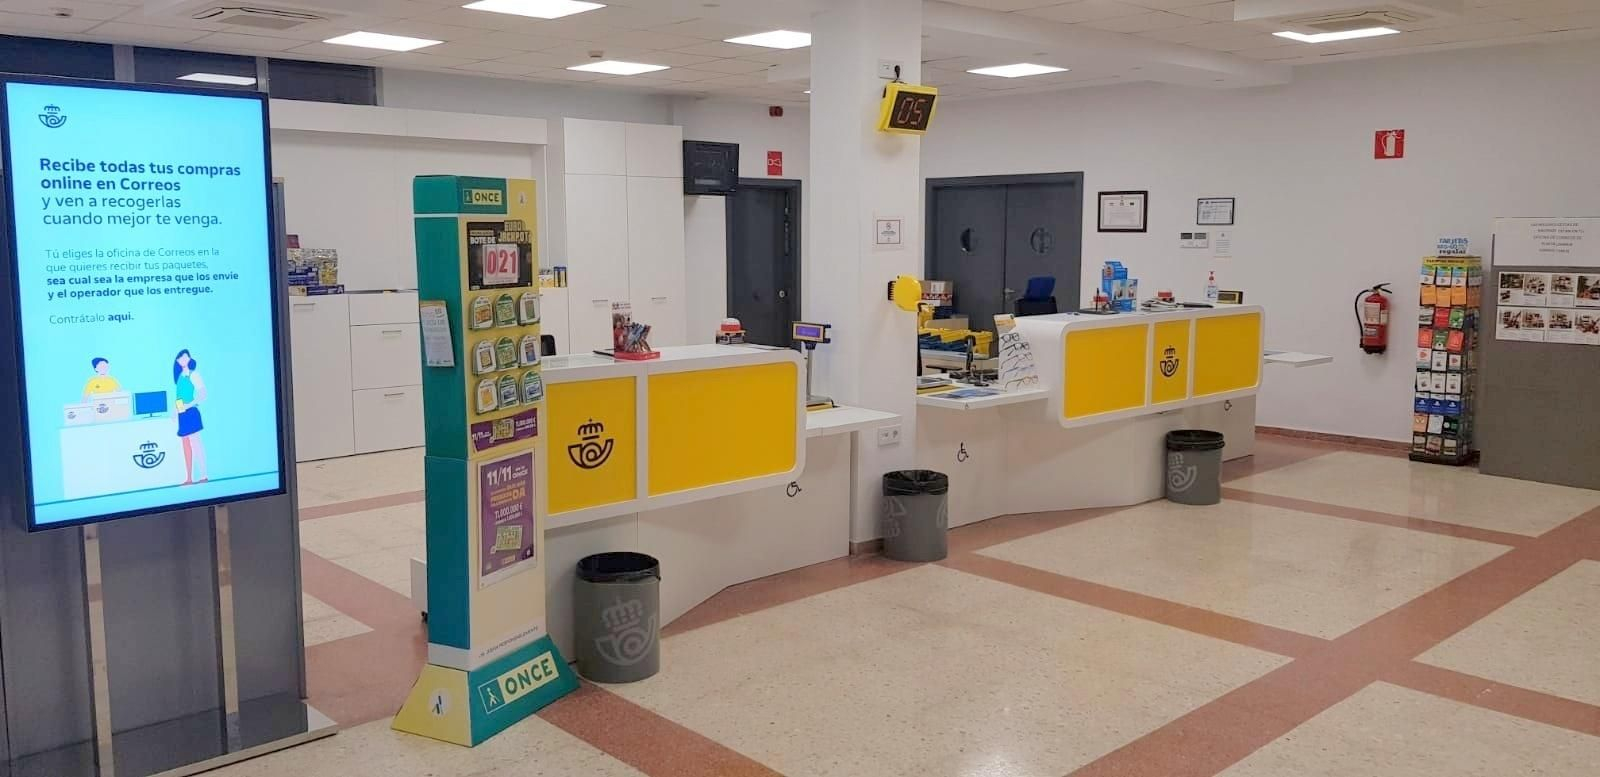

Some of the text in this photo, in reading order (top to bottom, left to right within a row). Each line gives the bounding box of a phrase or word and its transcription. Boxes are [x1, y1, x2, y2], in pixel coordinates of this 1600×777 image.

[897, 97, 928, 125] 05
[39, 157, 241, 178] Recibe todas tus compras
[40, 175, 181, 191] online en Correos
[41, 195, 182, 211] y ven a recogerlas
[474, 192, 500, 202] ONCE
[42, 211, 223, 228] cuando mejor te venga.
[44, 247, 220, 260] Tú eliges la oficina de Correos en la
[45, 263, 67, 275] que
[69, 262, 108, 273] quieres
[110, 261, 142, 271] recibir
[144, 261, 161, 270] tus
[487, 250, 516, 274] 021
[47, 276, 66, 286] sea
[68, 275, 92, 285] cual
[94, 275, 113, 285] sea
[114, 274, 125, 284] la
[127, 274, 173, 284] empresa
[175, 273, 193, 284] que
[196, 272, 211, 282] los
[47, 284, 213, 302] y el operador que los entregue.
[49, 312, 105, 323] Contrátalo
[487, 465, 512, 487] 11/11
[505, 658, 553, 695] ONCE
